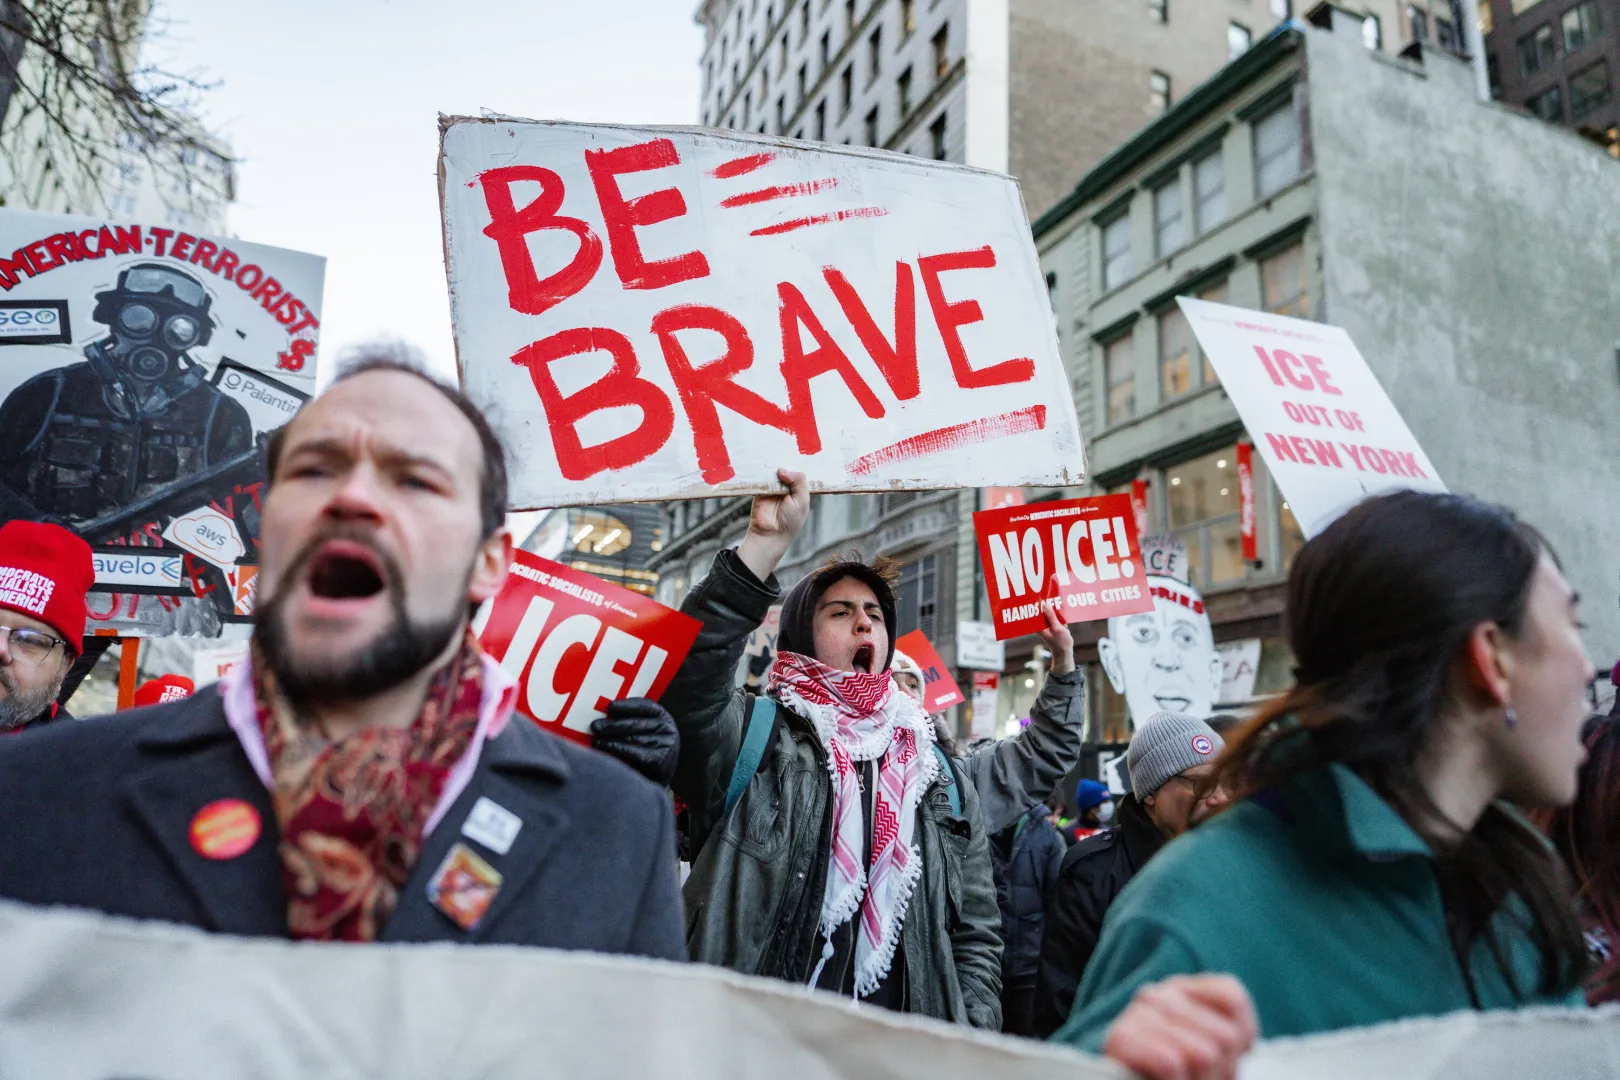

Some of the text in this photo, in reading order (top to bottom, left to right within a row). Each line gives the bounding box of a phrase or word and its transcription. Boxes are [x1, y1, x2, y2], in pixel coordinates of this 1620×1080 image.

[467, 138, 710, 315] BE
[510, 246, 1036, 485] BRAVE
[1253, 345, 1343, 396] ICE
[241, 380, 298, 414] Palantir
[1281, 400, 1365, 433] OUT OF
[1264, 432, 1429, 479] NEW YORK
[195, 524, 227, 547] aws
[93, 556, 156, 575] avelo
[988, 527, 1044, 600] NO
[1051, 516, 1135, 587] ICE!
[548, 576, 605, 607] SOCIALISTS
[1002, 601, 1040, 623] HANDS
[1067, 592, 1098, 608] OUR
[1101, 585, 1141, 603] CITIES
[164, 685, 188, 697] TAX
